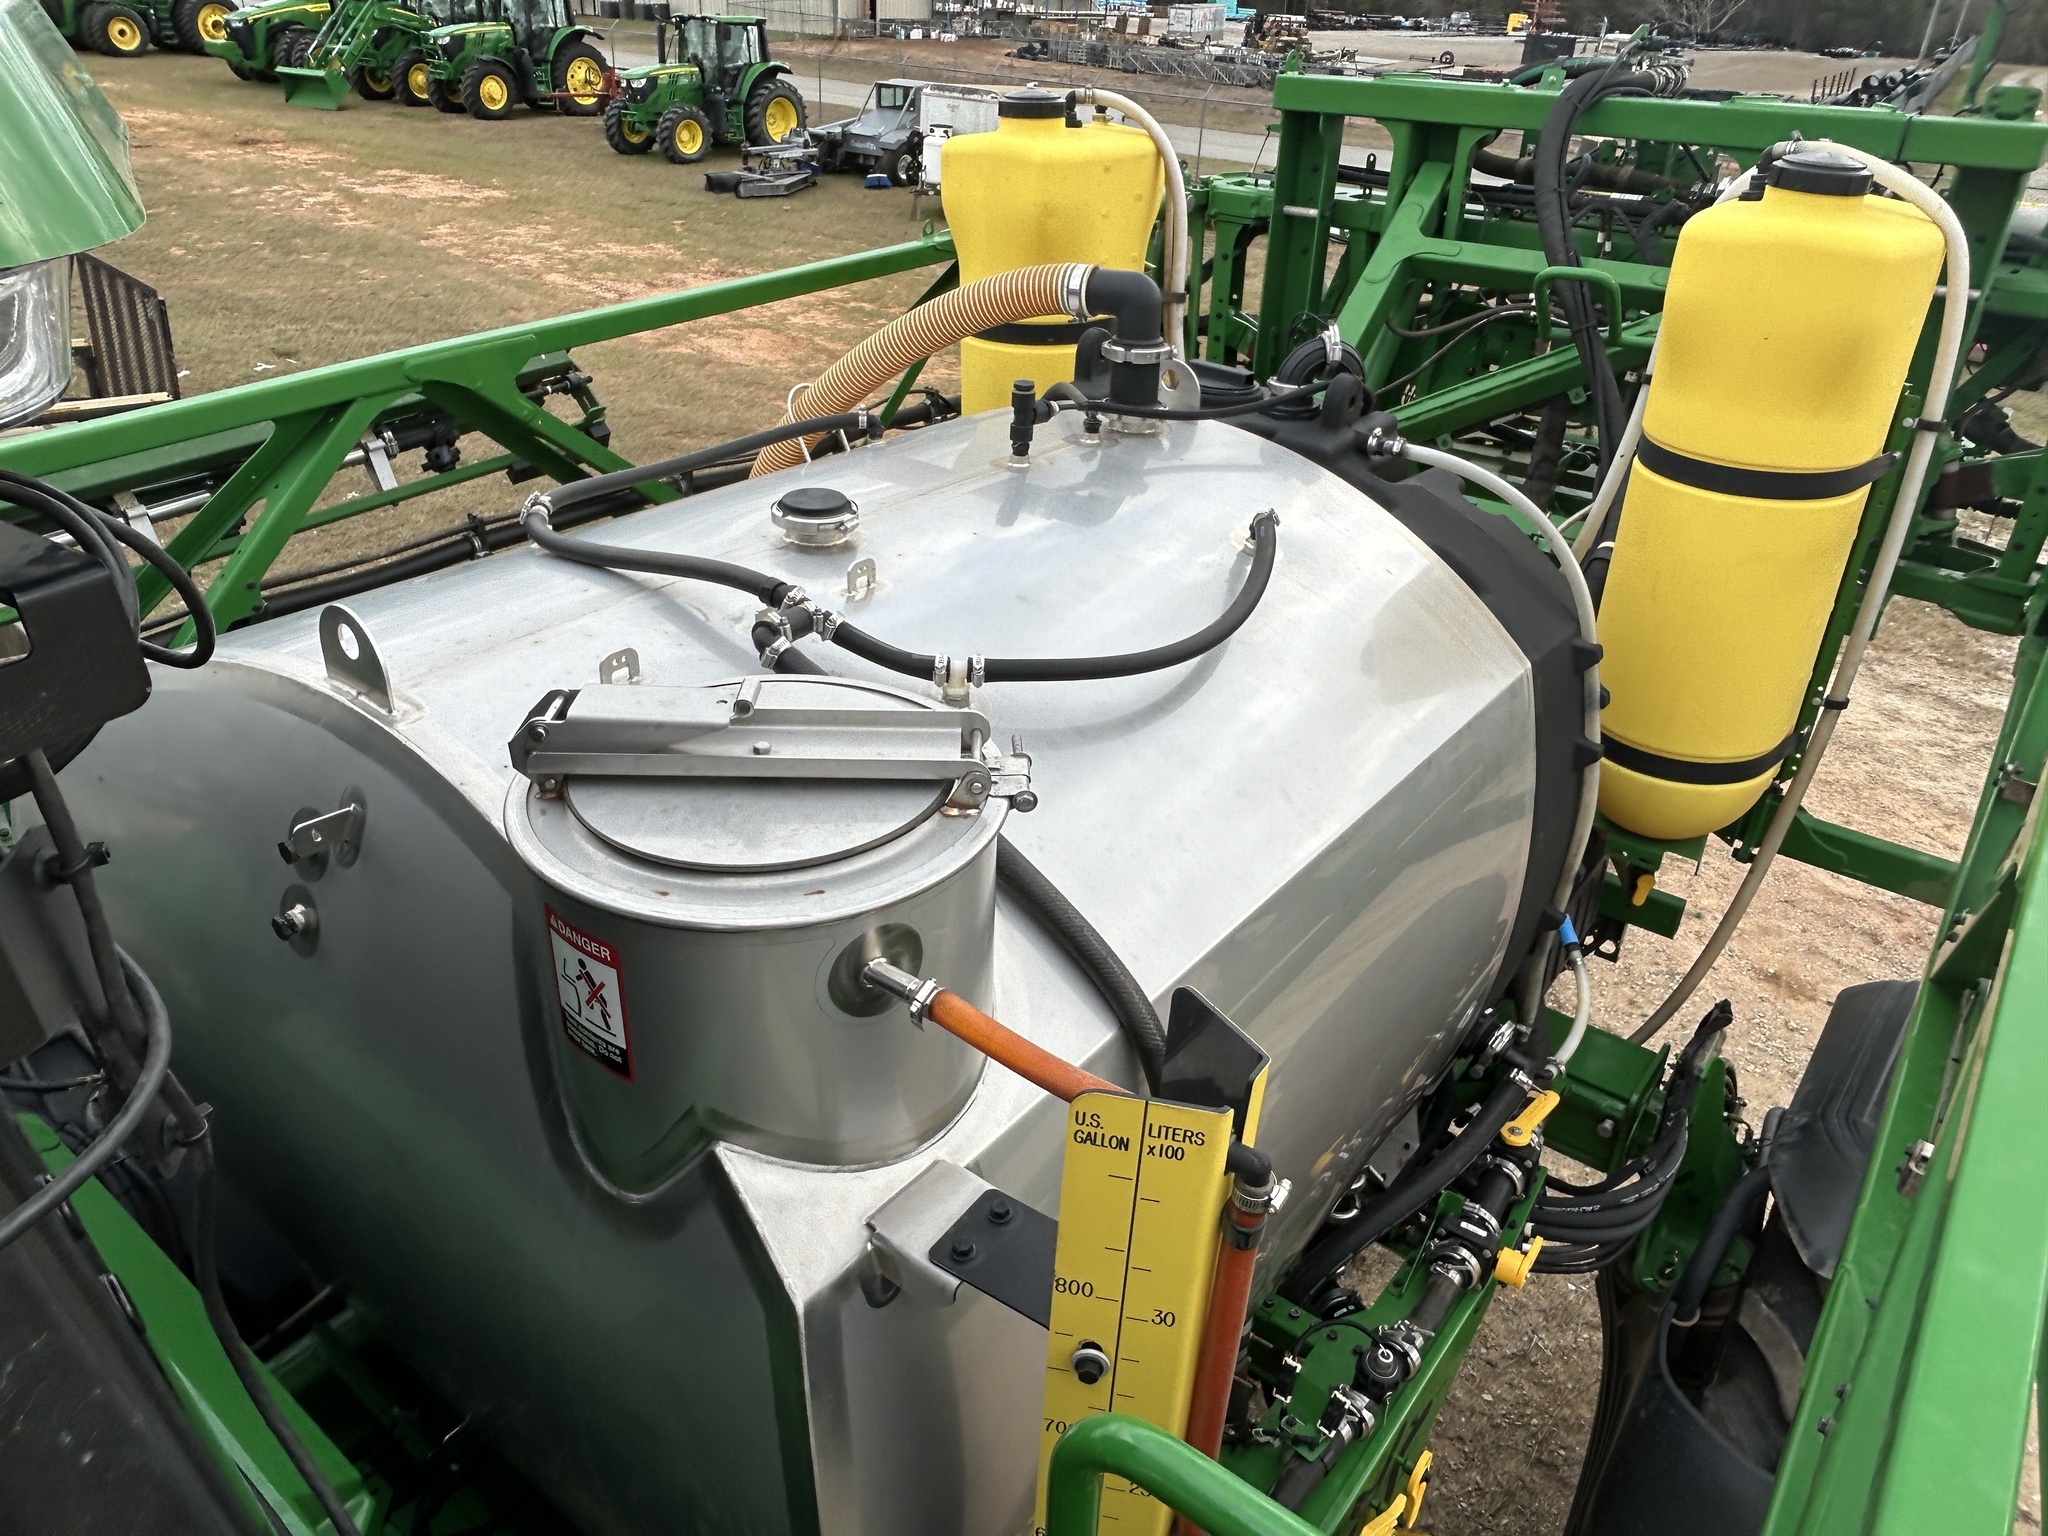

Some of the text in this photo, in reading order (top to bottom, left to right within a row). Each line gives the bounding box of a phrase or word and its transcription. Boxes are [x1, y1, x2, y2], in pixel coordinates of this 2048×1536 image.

[557, 920, 611, 962] DANGER
[1075, 1110, 1104, 1130] U.S.
[1074, 1130, 1129, 1151] GALLON
[1148, 1123, 1205, 1146] LITERS
[1054, 1277, 1093, 1298] 800
[1151, 1309, 1175, 1327] 30
[1044, 1418, 1073, 1434] 70
